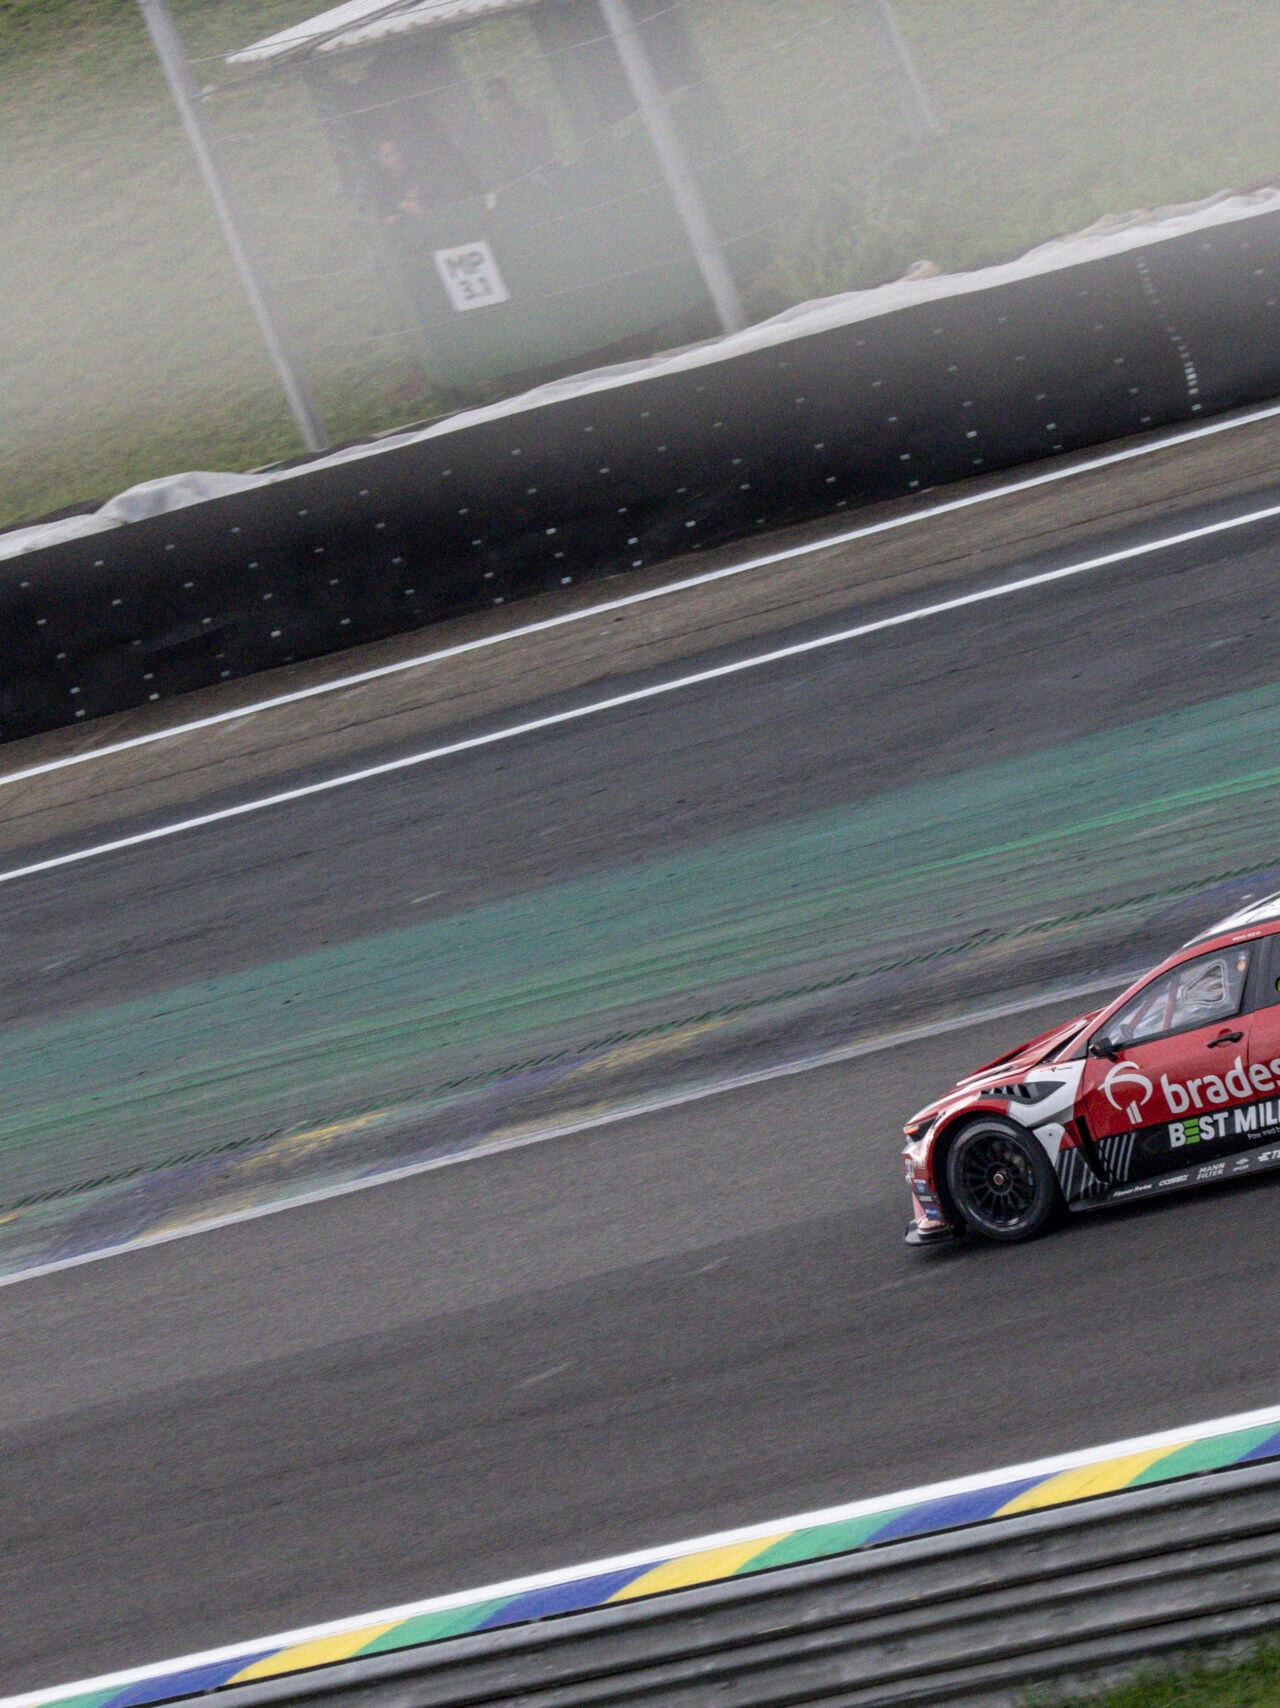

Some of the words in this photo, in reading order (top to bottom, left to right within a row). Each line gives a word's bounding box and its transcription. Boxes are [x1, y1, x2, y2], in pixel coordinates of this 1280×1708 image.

[1168, 1112, 1229, 1148] BEST
[1199, 1162, 1225, 1174] MANN
[1197, 1169, 1224, 1180] FILTER
